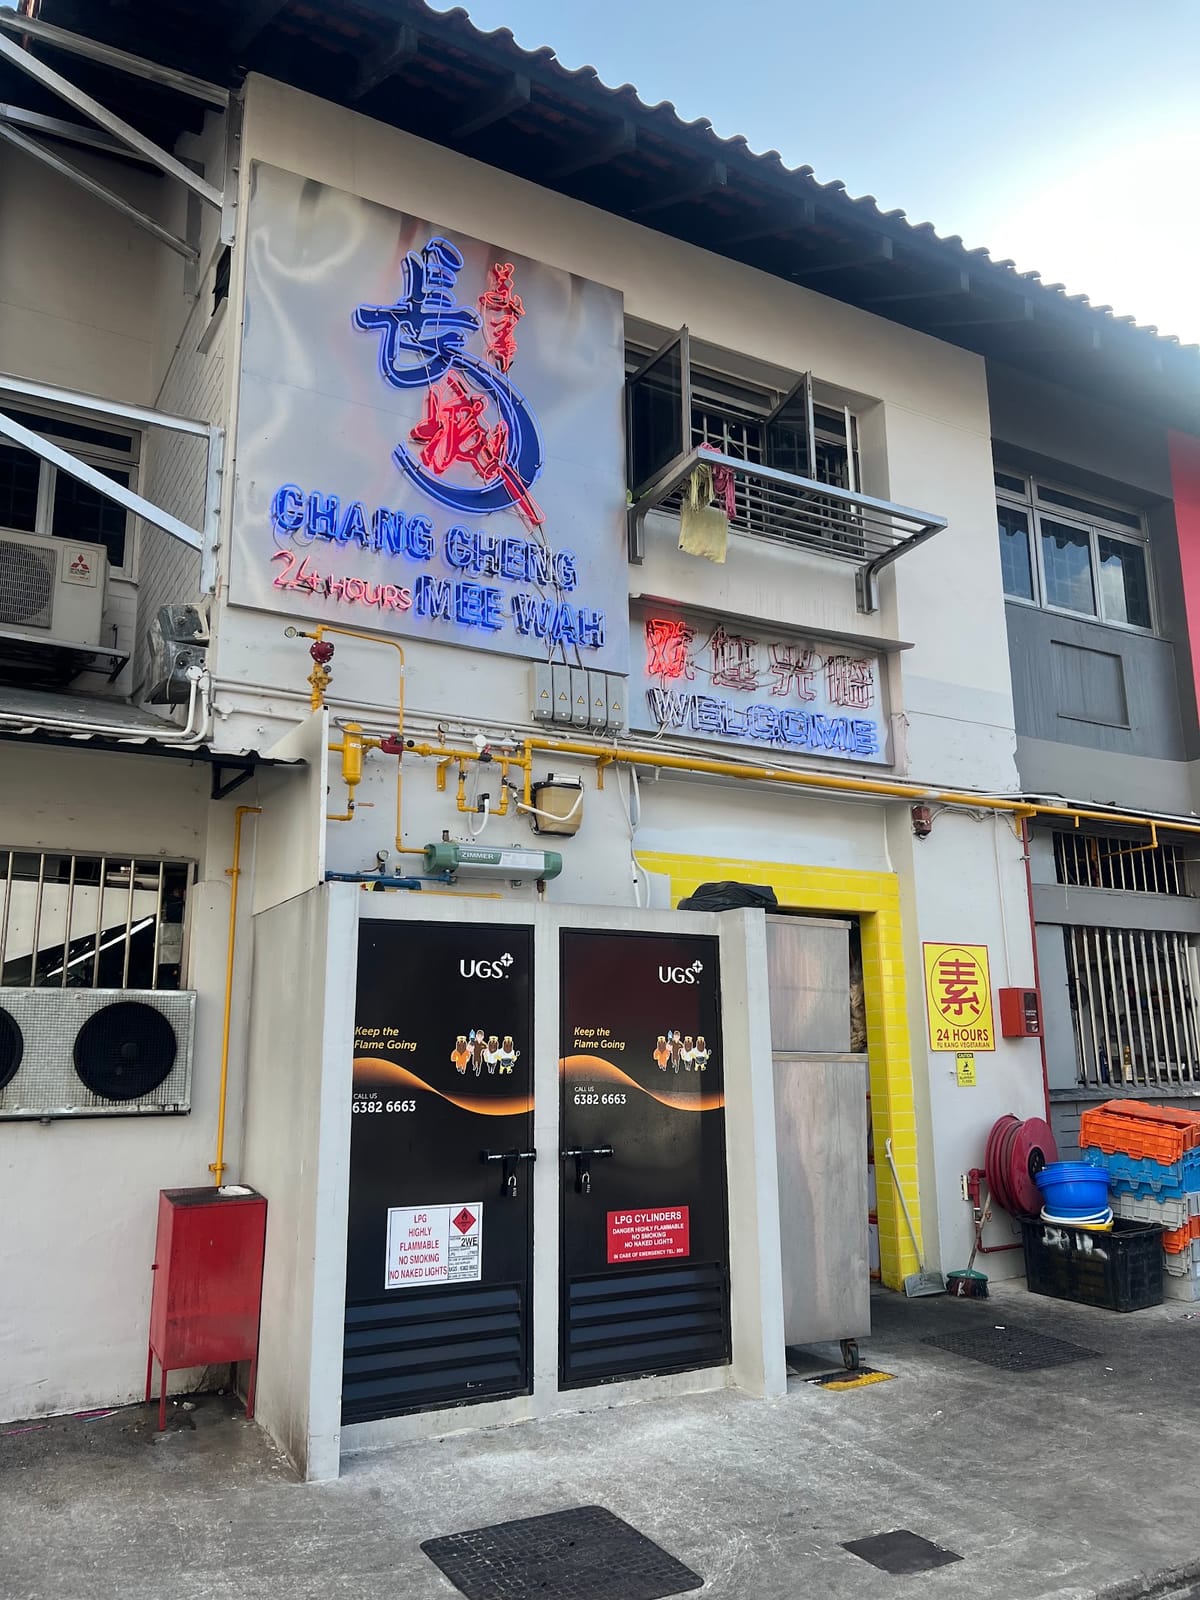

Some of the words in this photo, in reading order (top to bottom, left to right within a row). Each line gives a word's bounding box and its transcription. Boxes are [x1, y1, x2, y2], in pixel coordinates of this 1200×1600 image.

[272, 483, 436, 560] CHANG
[445, 524, 580, 592] CHENG
[326, 573, 413, 612] HOURS
[415, 574, 505, 631] MEE
[511, 592, 607, 649] WAH
[648, 687, 880, 755] WELCOME
[461, 852, 494, 860] ZIMMER
[460, 959, 503, 978] UGS
[659, 966, 696, 984] UGS
[938, 958, 980, 1016] 素
[355, 1026, 380, 1037] Keep
[382, 1027, 399, 1036] the
[574, 1027, 595, 1037] Keep
[596, 1028, 610, 1036] the
[936, 1029, 950, 1041] 24
[953, 1029, 989, 1041] HOURS
[354, 1040, 384, 1049] Flame
[387, 1040, 417, 1051] Going
[574, 1040, 599, 1048] Flame
[601, 1040, 625, 1050] Going
[960, 1041, 990, 1049] VEGETARIAN
[574, 1094, 599, 1105] 6382
[601, 1094, 626, 1105] 6663
[352, 1102, 383, 1113] 6382
[386, 1101, 416, 1112] 6663
[413, 1214, 427, 1223] LPG
[615, 1215, 633, 1224] LPG
[634, 1212, 682, 1222] CYLINDERS
[408, 1227, 432, 1237] HIGHLY
[612, 1227, 635, 1235] DANGER
[635, 1225, 653, 1233] HIGHLY
[653, 1223, 685, 1231] FLAMMABLE
[399, 1240, 439, 1251] FLAMMABLE
[461, 1237, 478, 1247] 2WE
[398, 1257, 408, 1265] NO
[409, 1254, 440, 1264] SMOKING
[389, 1271, 399, 1279] NO
[400, 1268, 424, 1278] NAKED
[424, 1266, 448, 1276] LIGHTS
